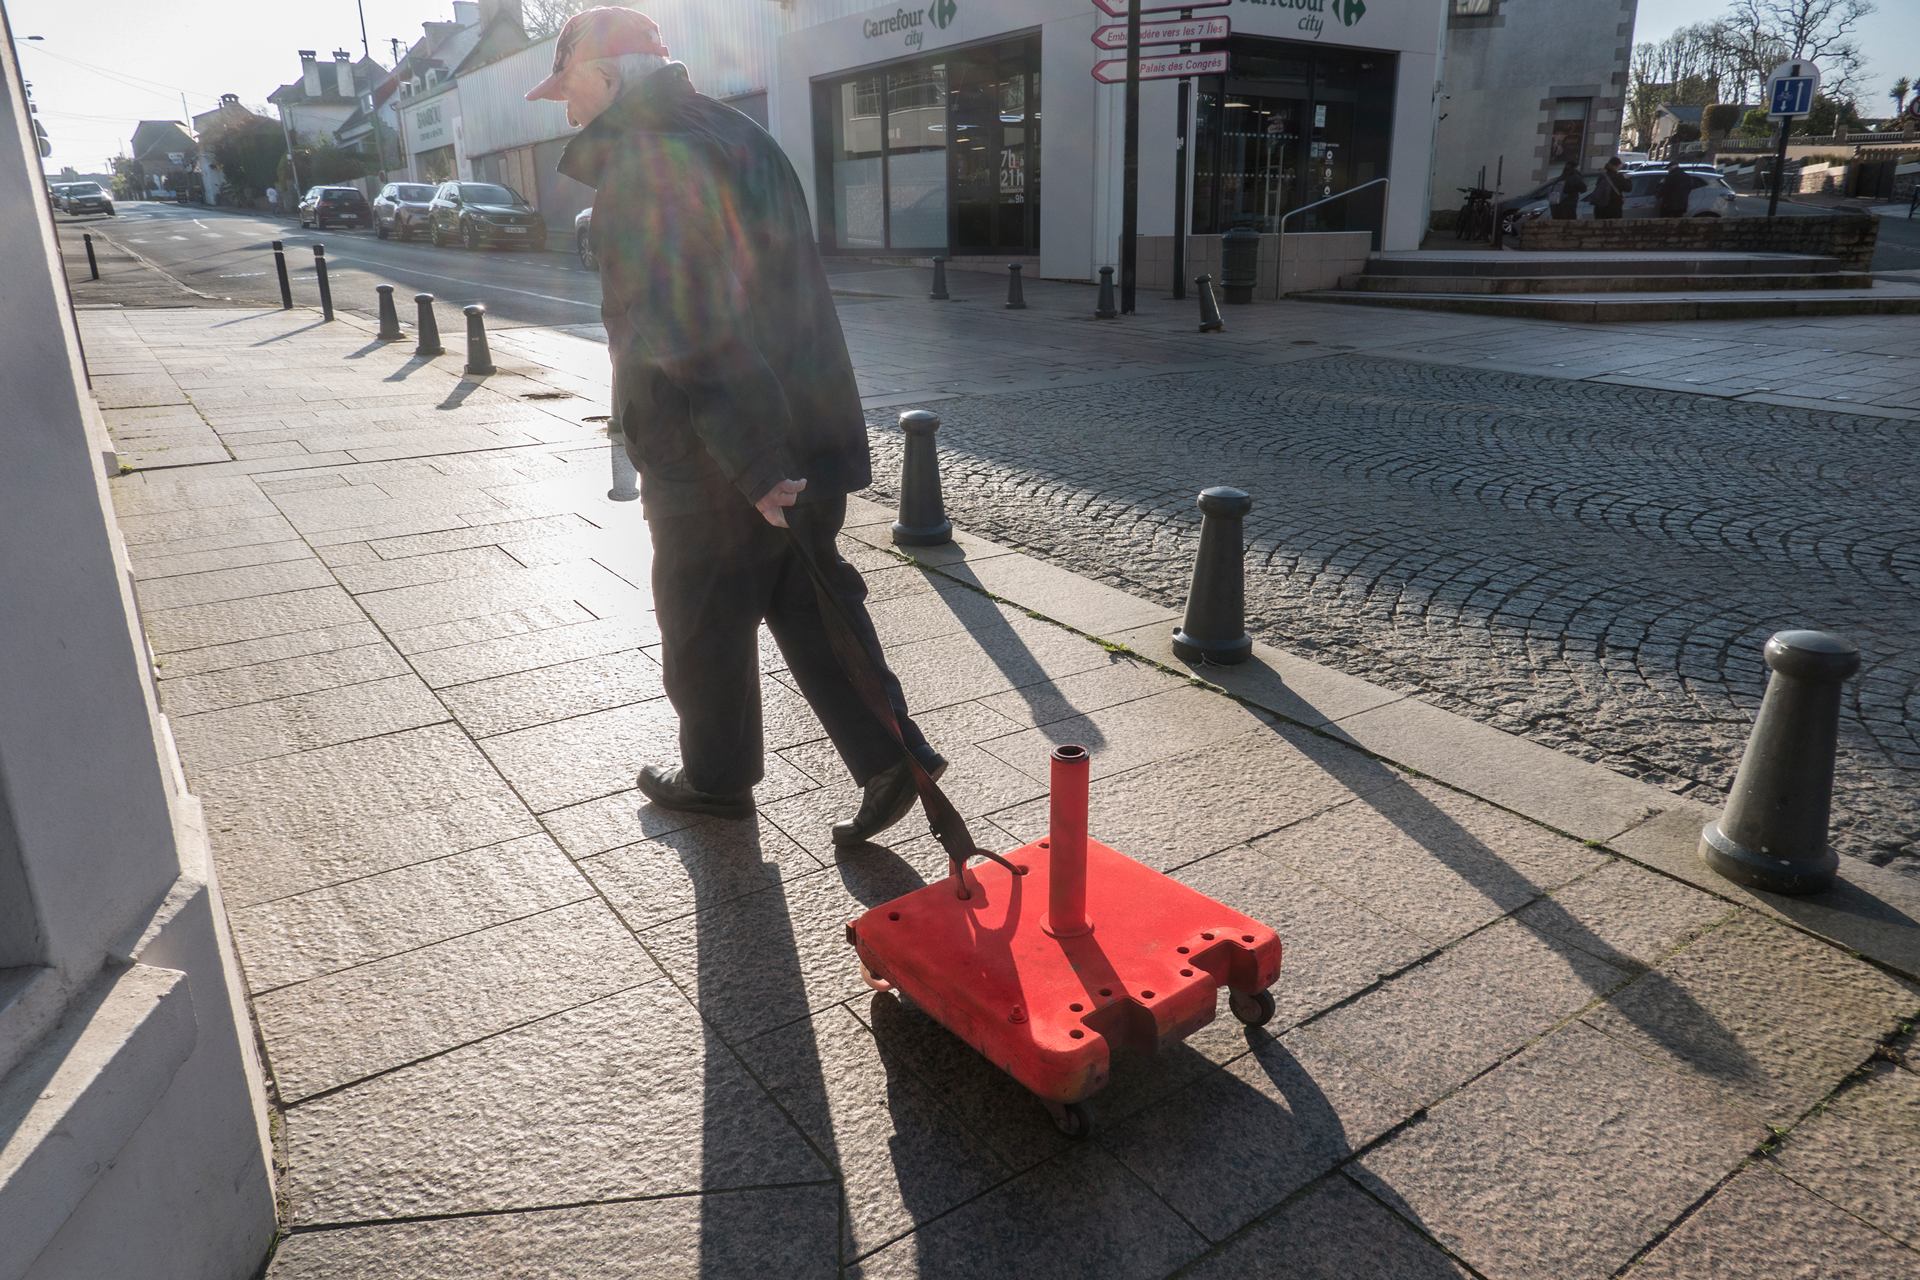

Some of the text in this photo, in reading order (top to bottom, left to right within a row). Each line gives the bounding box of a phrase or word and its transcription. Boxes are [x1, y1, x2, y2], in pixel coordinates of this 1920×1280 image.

[863, 8, 924, 39] Carrefour
[1162, 28, 1180, 39] vers
[1183, 26, 1195, 36] les
[1198, 24, 1204, 34] 7
[1298, 14, 1324, 39] city
[904, 30, 923, 50] city
[1139, 62, 1166, 73] Palais
[1168, 61, 1183, 71] des
[1000, 148, 1016, 168] 7h
[1000, 168, 1025, 187] 21h
